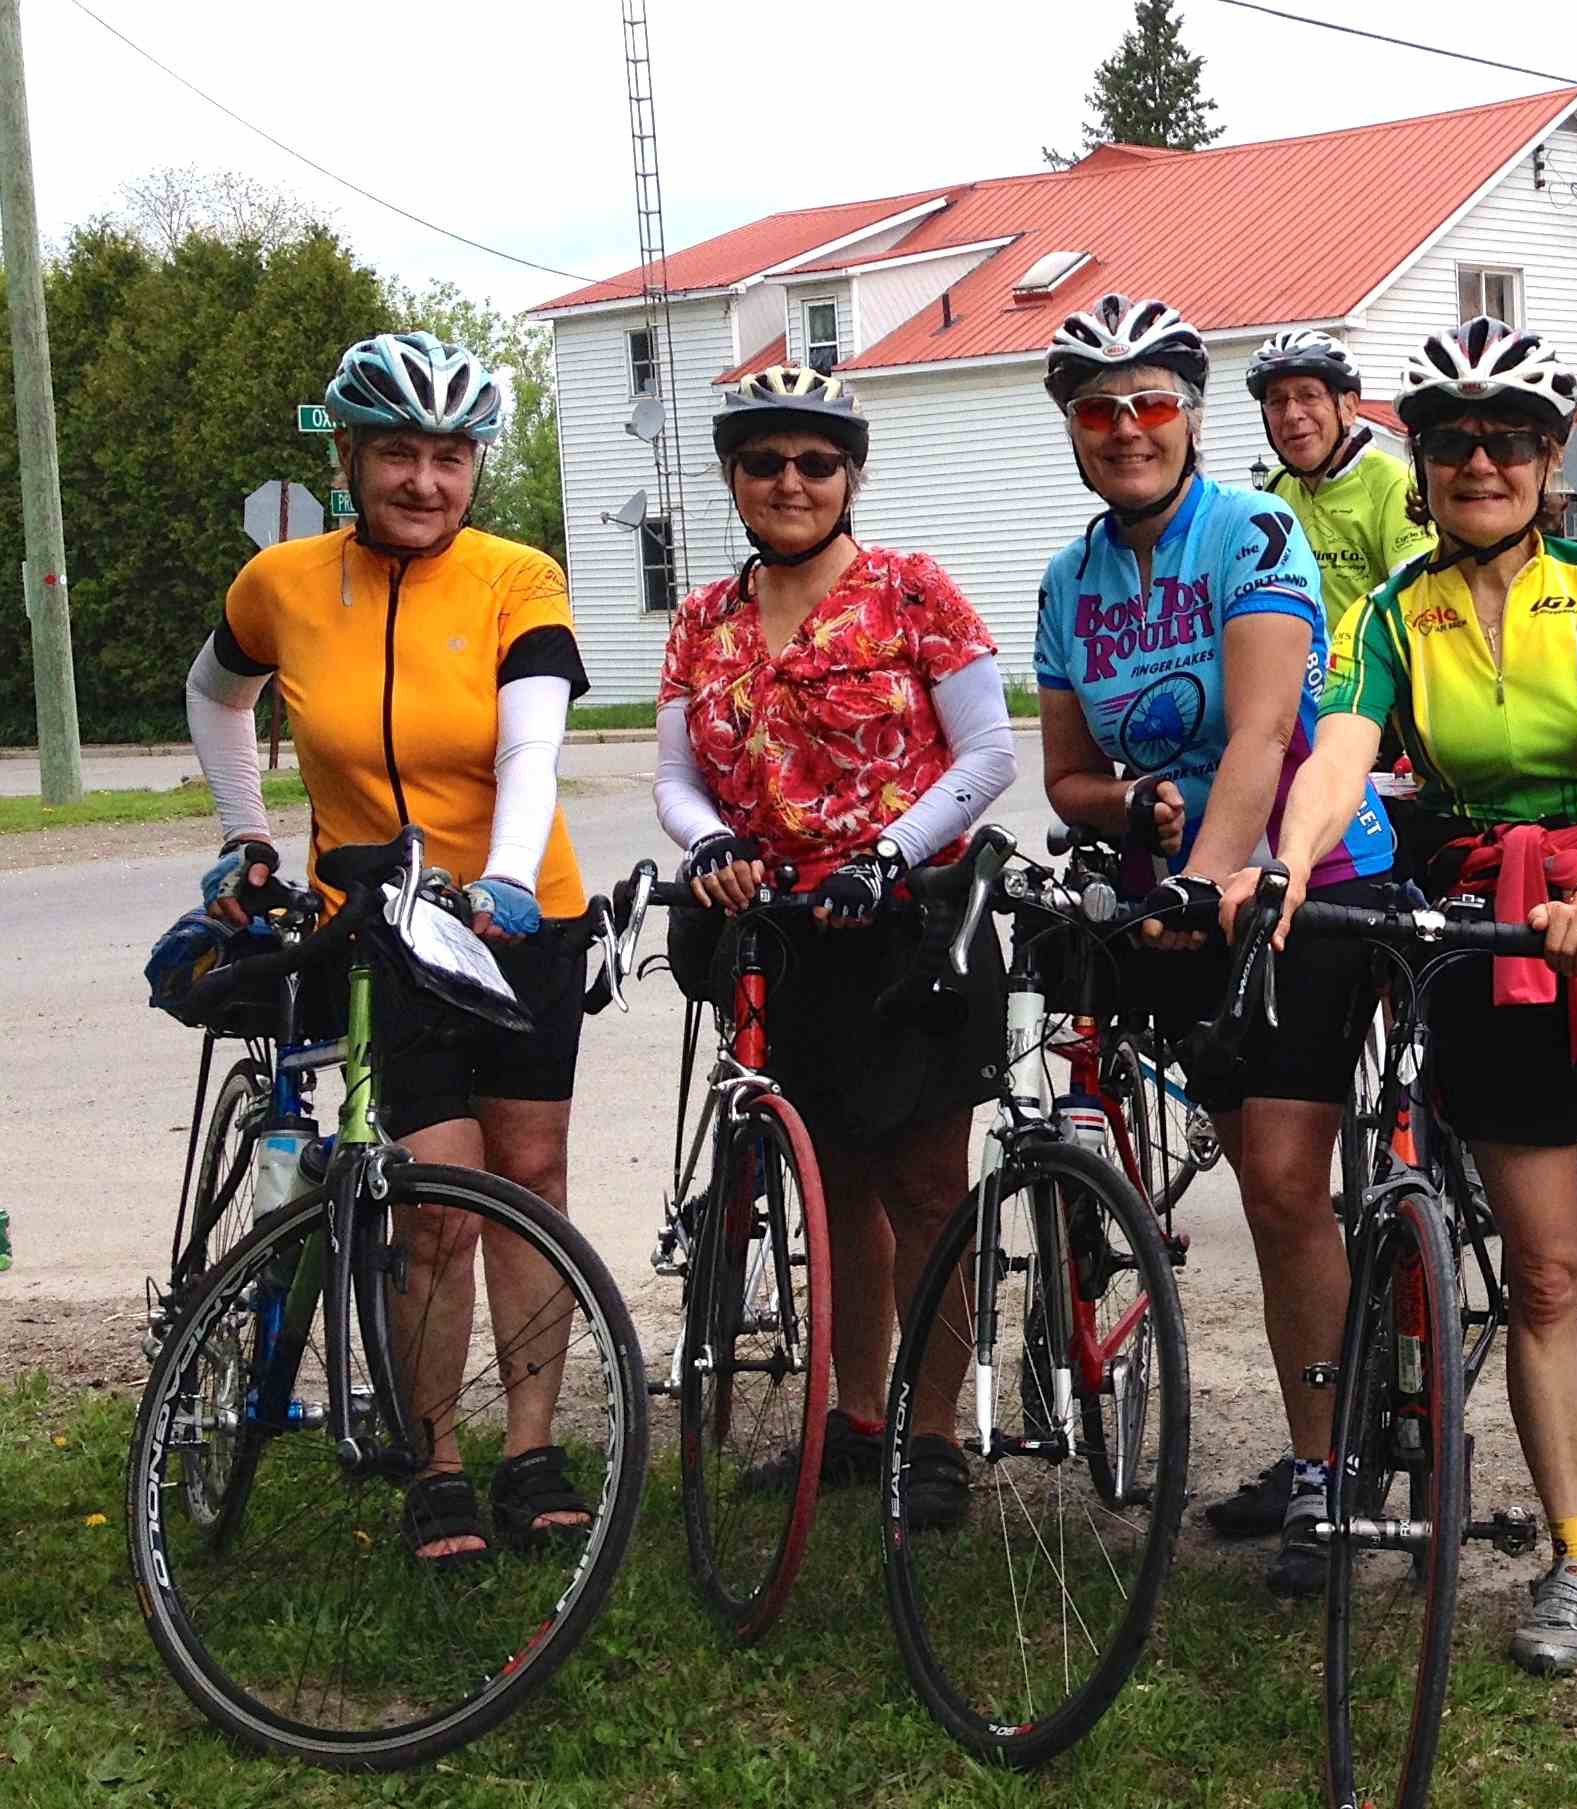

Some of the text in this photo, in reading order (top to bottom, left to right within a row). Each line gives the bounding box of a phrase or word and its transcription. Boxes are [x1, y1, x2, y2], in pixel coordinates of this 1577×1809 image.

[1235, 544, 1259, 561] the
[1074, 573, 1210, 638] BON TON
[1083, 602, 1216, 684] ROULET
[1131, 650, 1216, 678] FINGER LAKES
[1306, 652, 1325, 703] BON
[891, 1381, 910, 1518] EASTON
